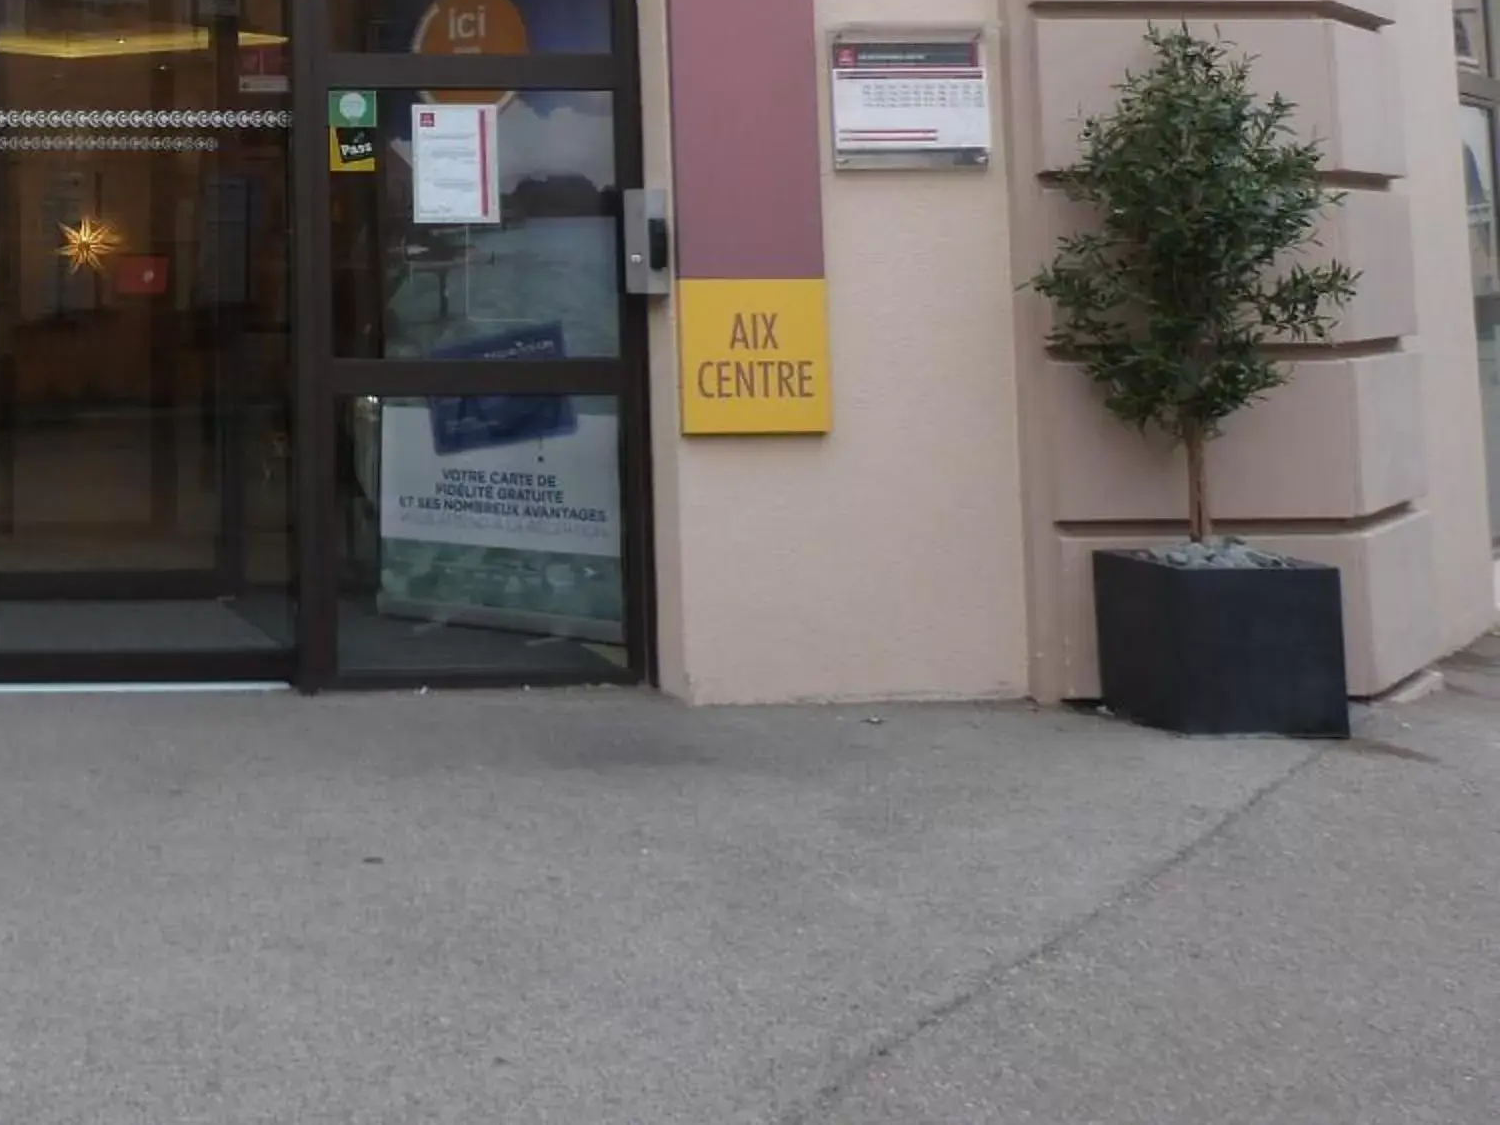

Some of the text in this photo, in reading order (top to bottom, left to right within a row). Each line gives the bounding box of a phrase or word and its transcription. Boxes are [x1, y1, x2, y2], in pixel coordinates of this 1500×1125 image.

[449, 4, 485, 40] ici
[729, 313, 779, 350] AIX
[697, 360, 815, 399] CENTRE
[442, 468, 557, 488] VOTRE CARTE DE
[496, 487, 564, 504] GRATUITE
[443, 499, 519, 517] NOMBREUX
[522, 504, 608, 523] AVANTAGES
